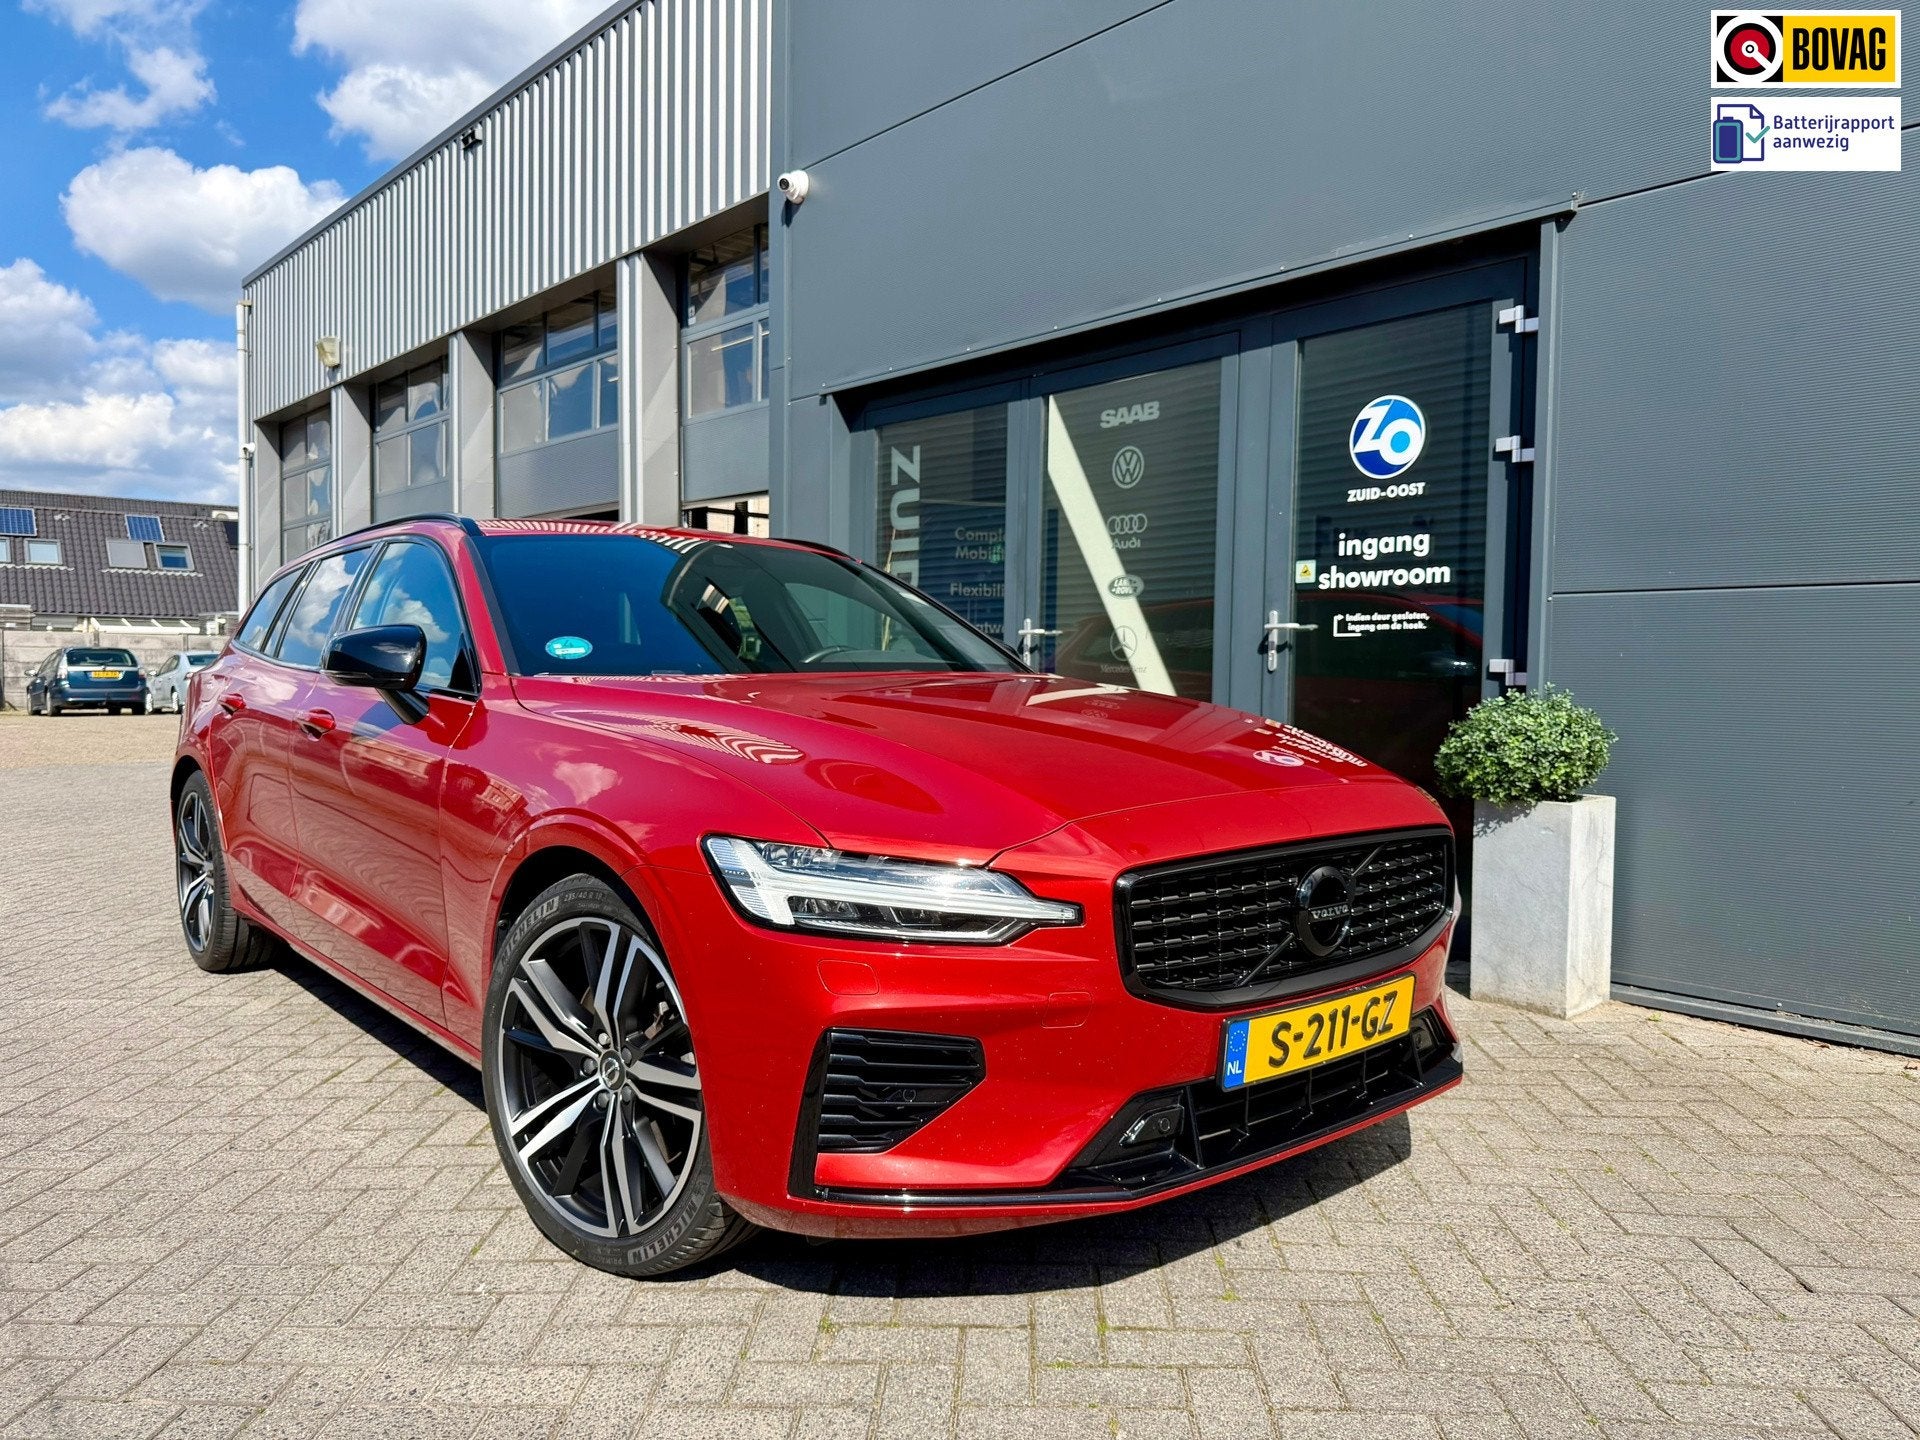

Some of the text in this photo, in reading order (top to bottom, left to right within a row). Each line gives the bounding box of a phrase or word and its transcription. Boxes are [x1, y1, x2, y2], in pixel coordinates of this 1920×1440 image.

[1100, 401, 1160, 428] SAAB
[1347, 482, 1426, 502] ZUID-OOST
[1112, 537, 1141, 549] Audi
[1338, 533, 1430, 560] ingang
[1318, 565, 1450, 589] showroom
[1345, 611, 1430, 622] Indien deur gesloten,
[1348, 622, 1376, 632] ingang
[1391, 621, 1403, 630] de
[1311, 905, 1349, 919] VOLVO
[1268, 990, 1398, 1069] S-211-GZ
[1227, 1061, 1242, 1076] NL
[628, 1198, 700, 1265] MICHELIN
